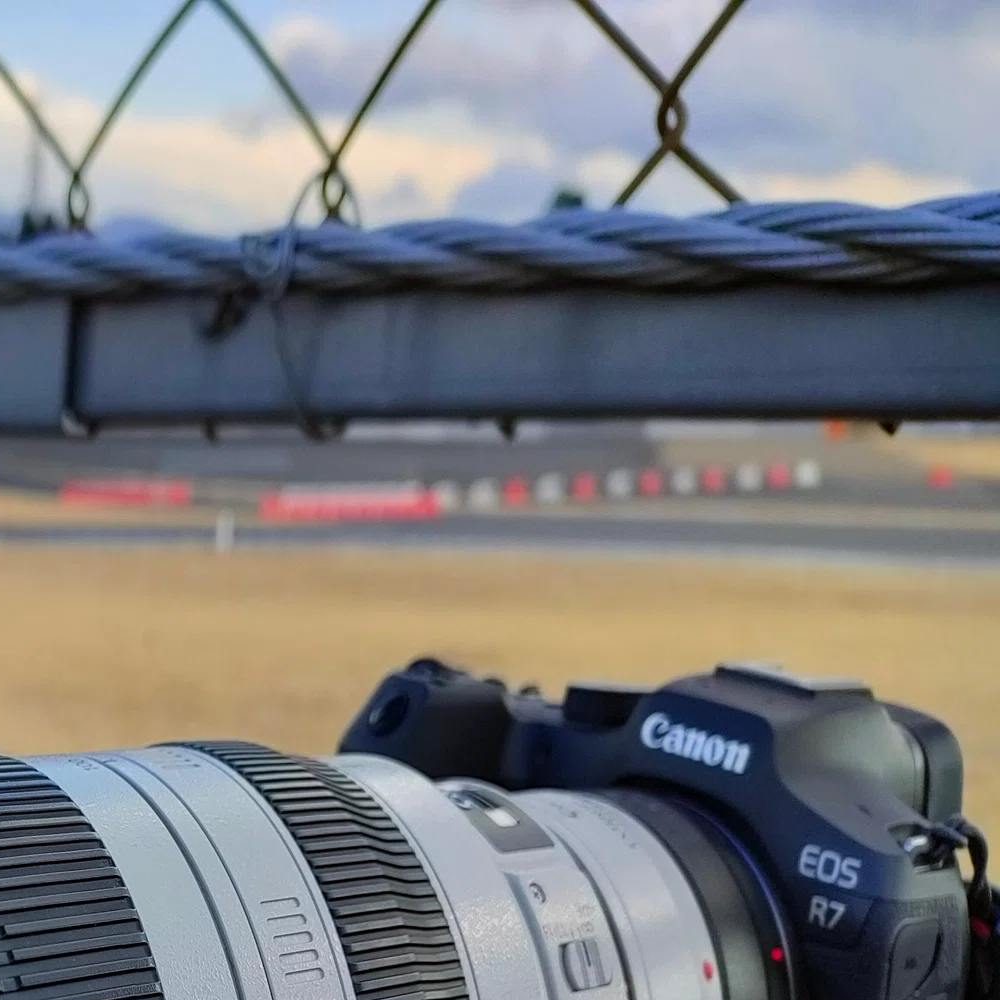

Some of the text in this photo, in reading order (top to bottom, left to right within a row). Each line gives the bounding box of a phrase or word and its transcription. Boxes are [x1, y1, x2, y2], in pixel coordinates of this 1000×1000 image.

[639, 711, 751, 775] Canon
[798, 843, 863, 890] EOS
[807, 894, 847, 931] R7
